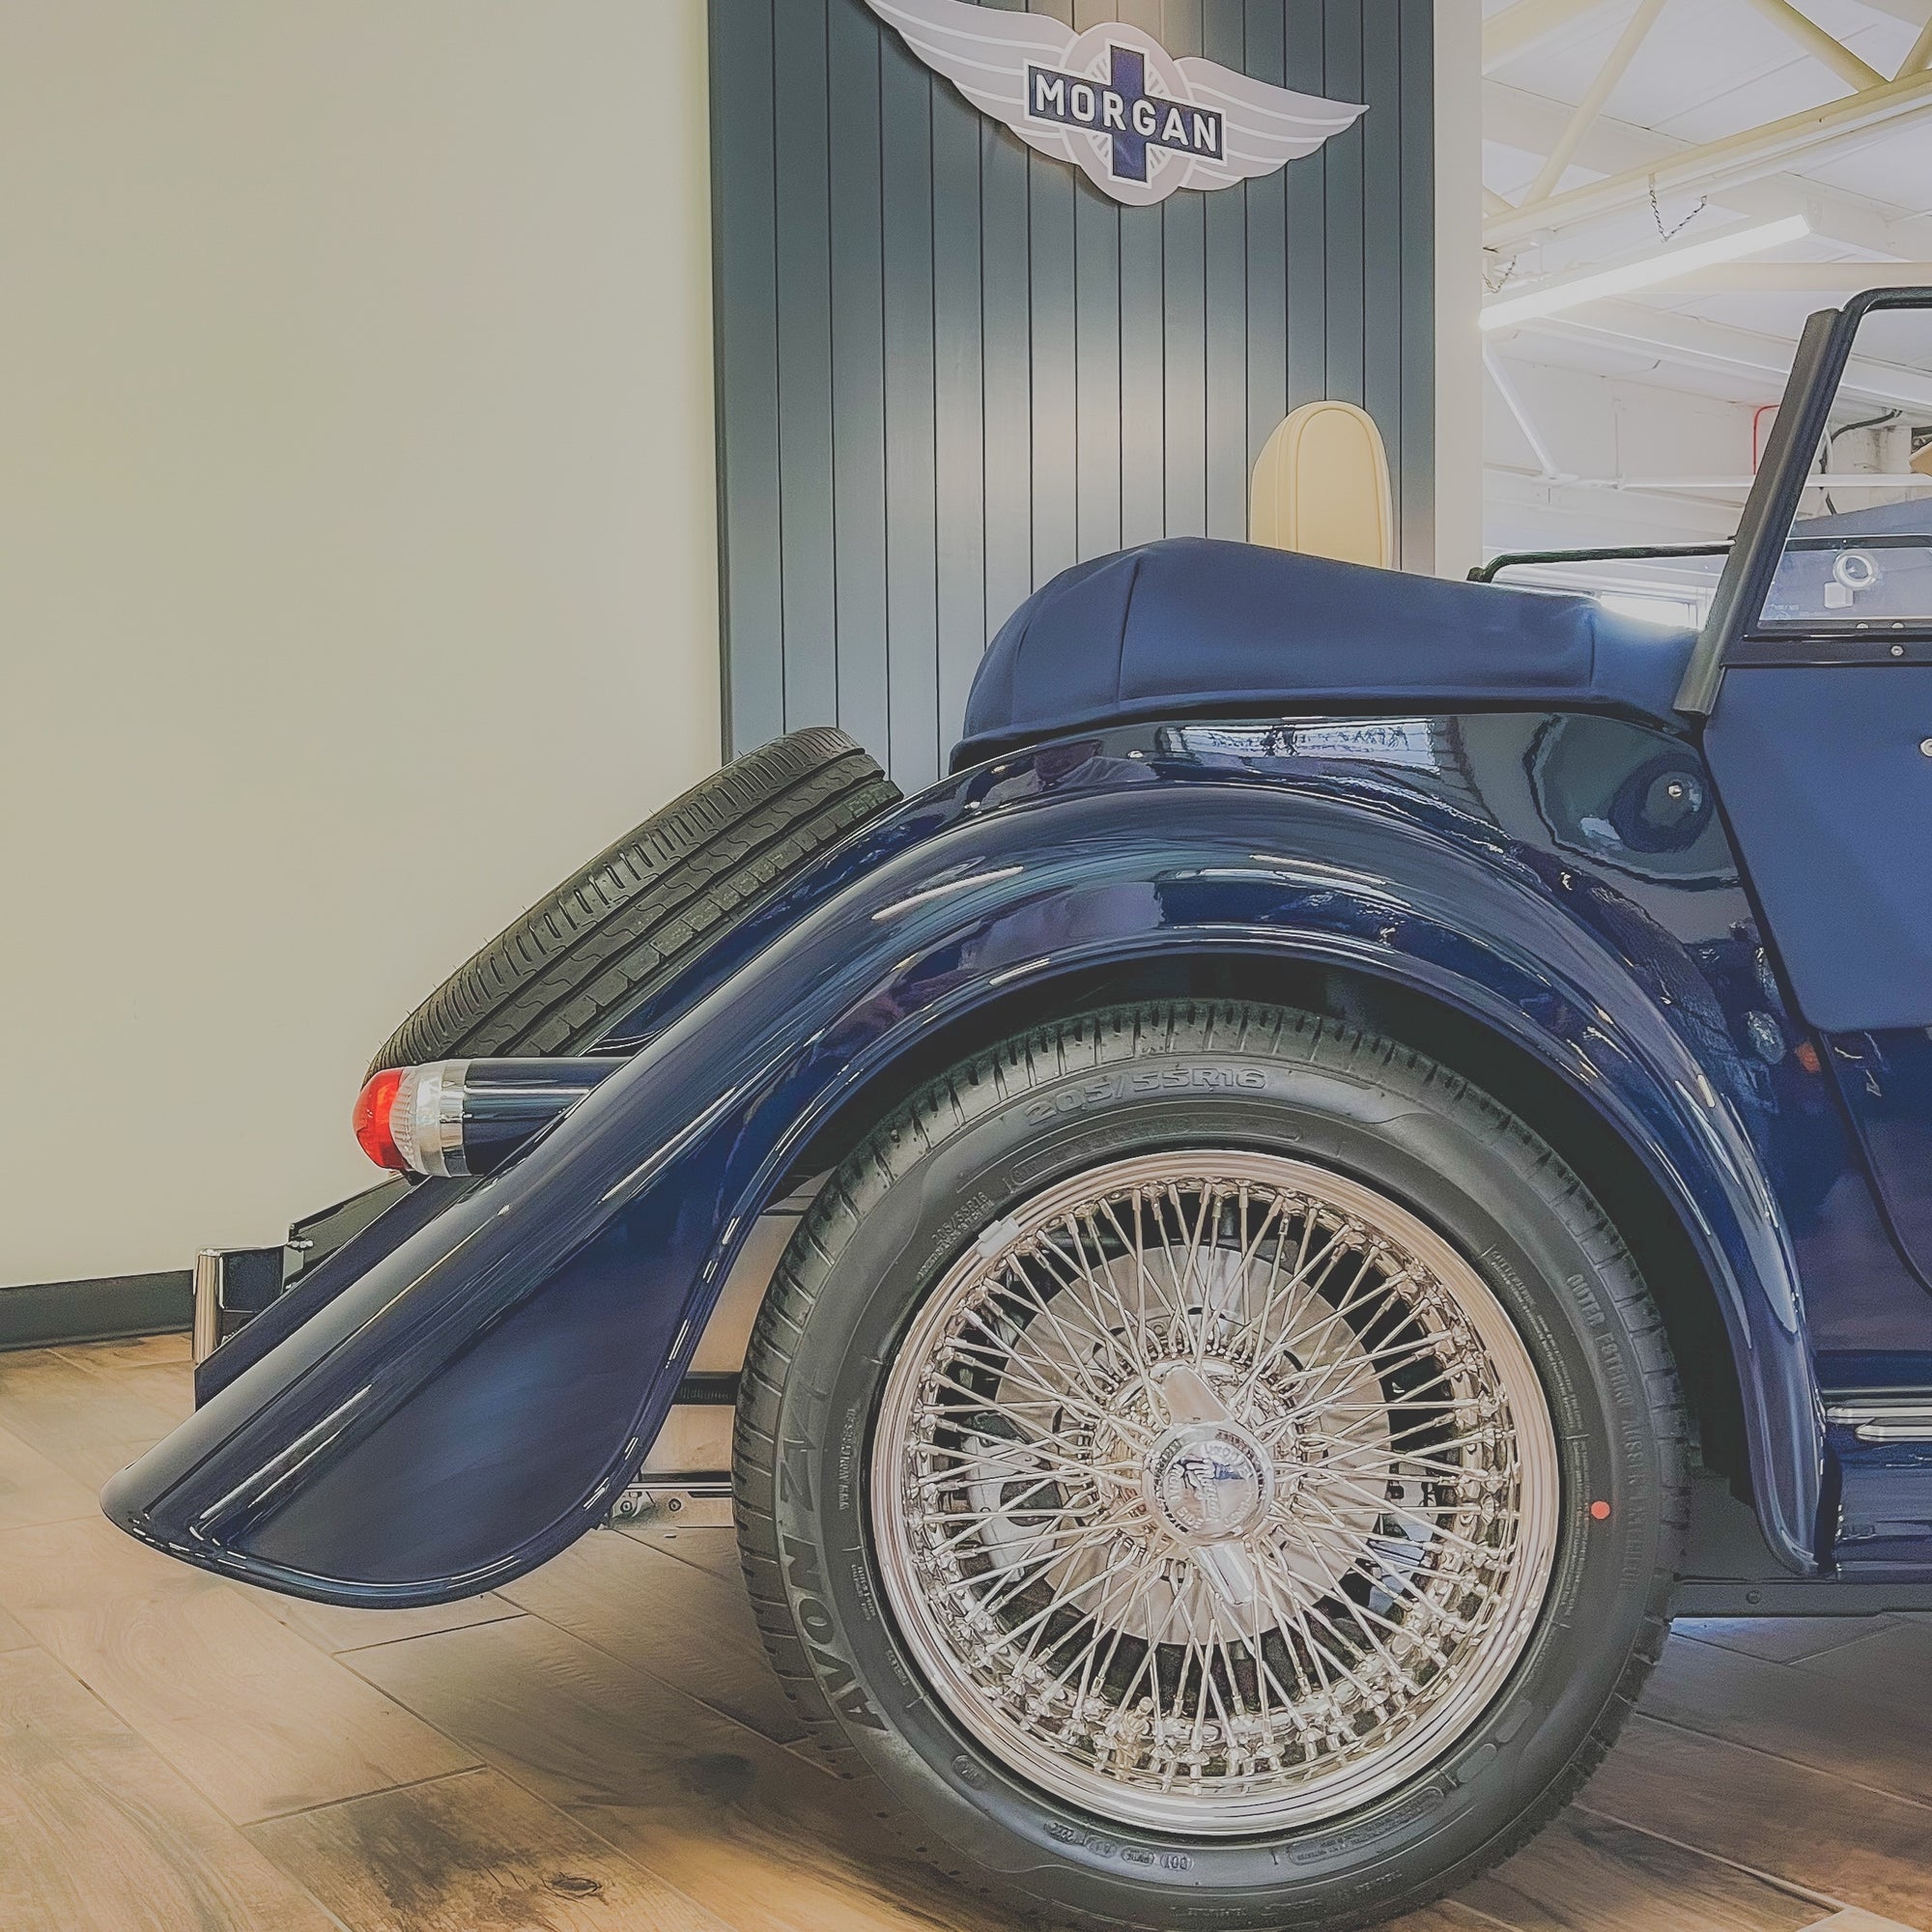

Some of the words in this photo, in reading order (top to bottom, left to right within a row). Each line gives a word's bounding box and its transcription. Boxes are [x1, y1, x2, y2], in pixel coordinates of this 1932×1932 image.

[1035, 74, 1217, 152] MORGAN
[1025, 1067, 1266, 1127] 205/55R16
[781, 1534, 889, 1731] AVON
